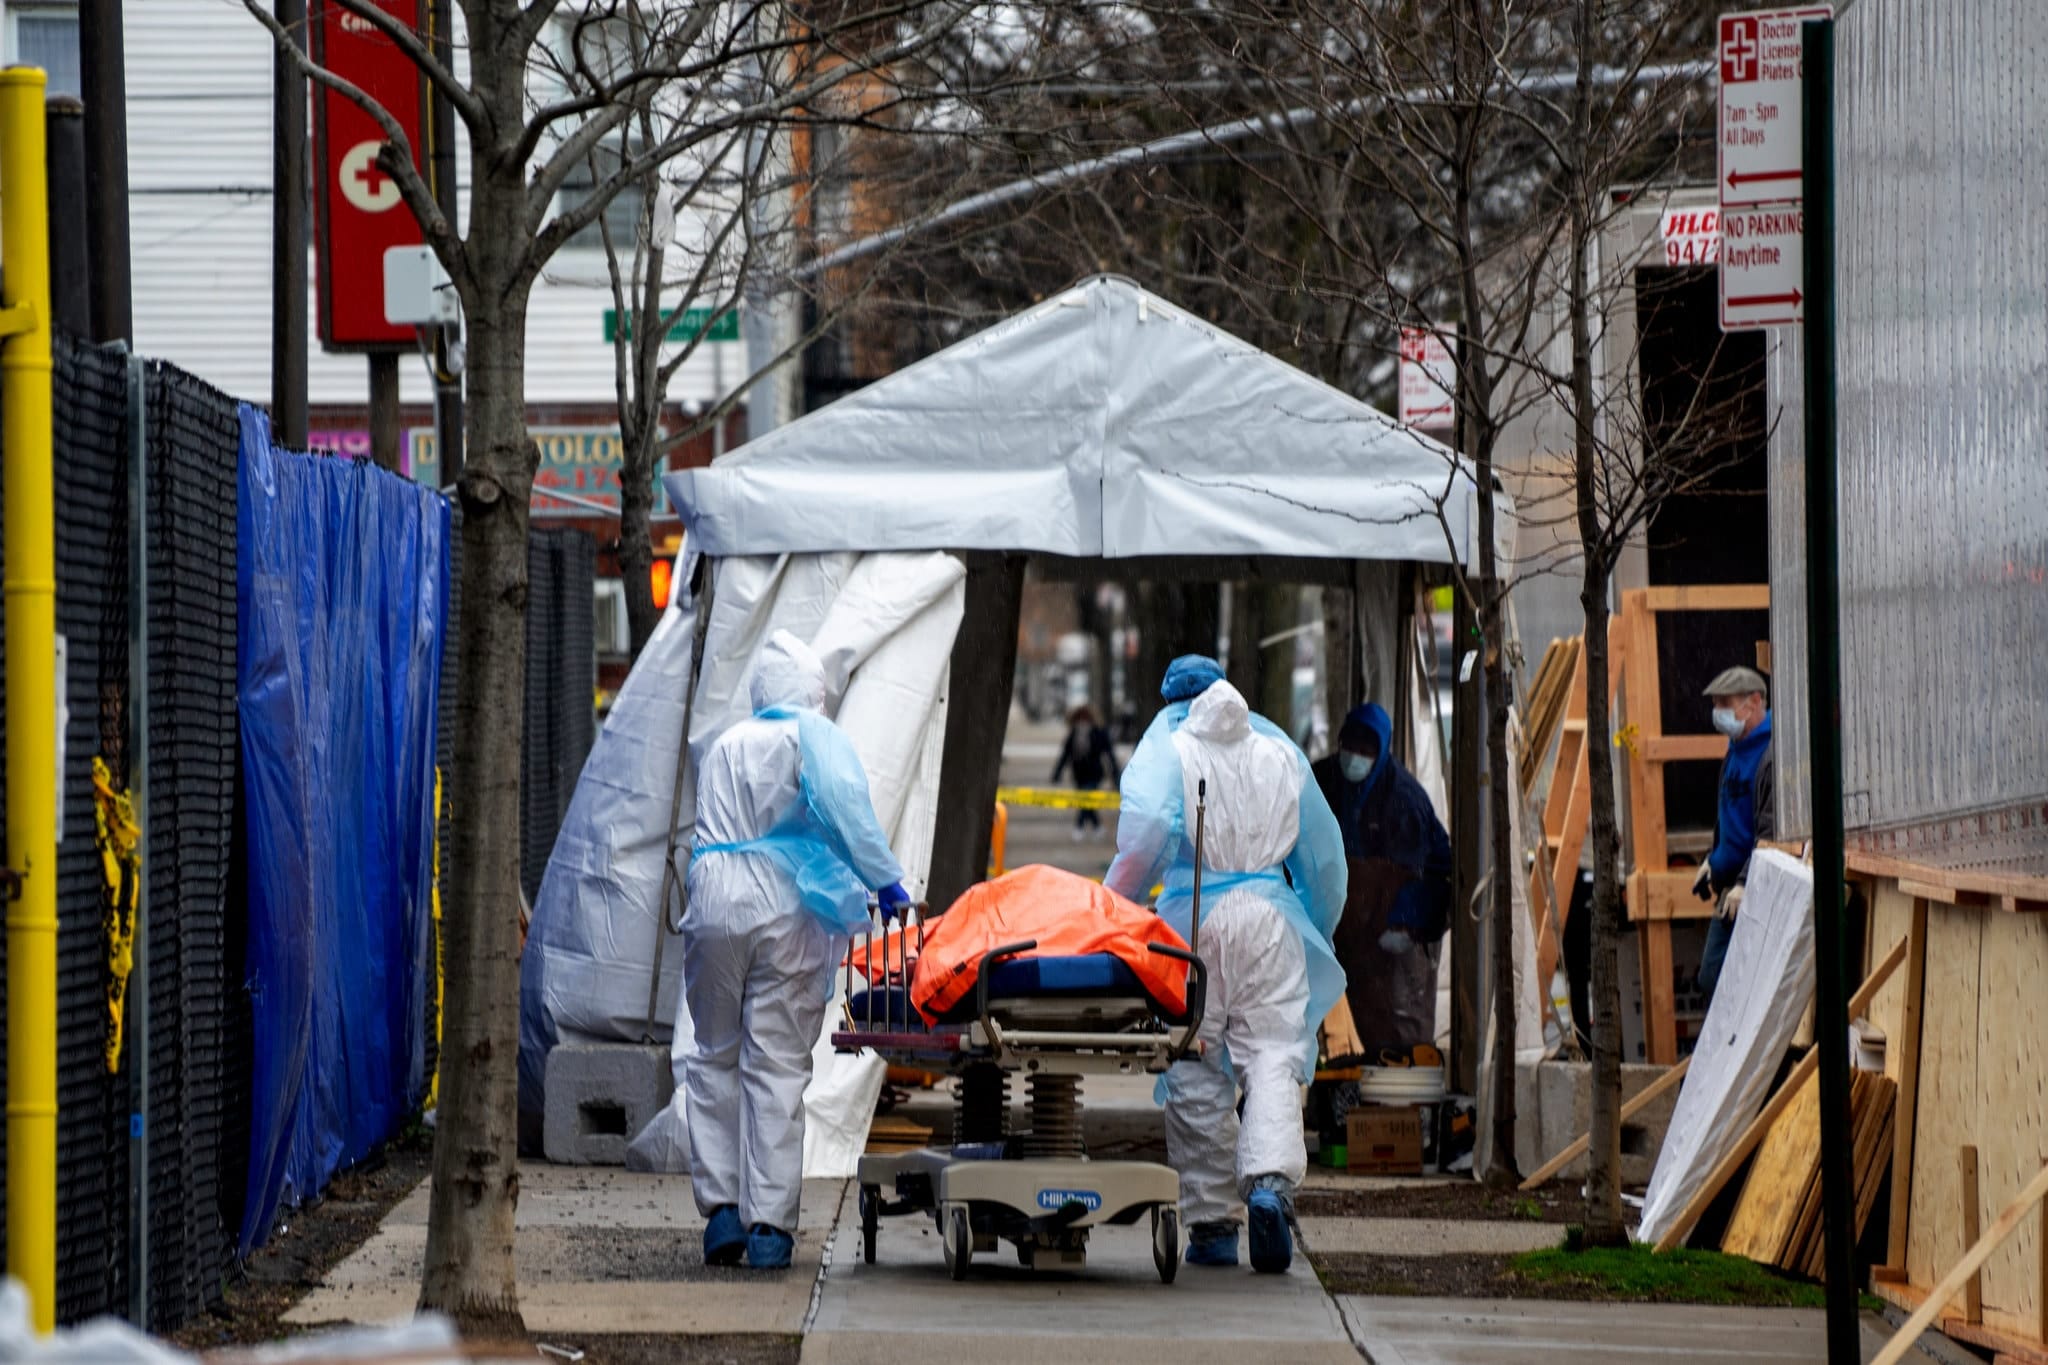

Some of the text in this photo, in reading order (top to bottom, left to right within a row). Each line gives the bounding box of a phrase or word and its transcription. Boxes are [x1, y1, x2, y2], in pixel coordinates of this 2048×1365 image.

[1761, 22, 1797, 39] Doctor
[1761, 61, 1795, 80] Plates
[1725, 104, 1748, 122] 7am
[1756, 101, 1778, 122] 5pm
[1726, 126, 1766, 148] All Days
[1727, 210, 1803, 238] NO PARKING
[1727, 244, 1780, 272] Anytime
